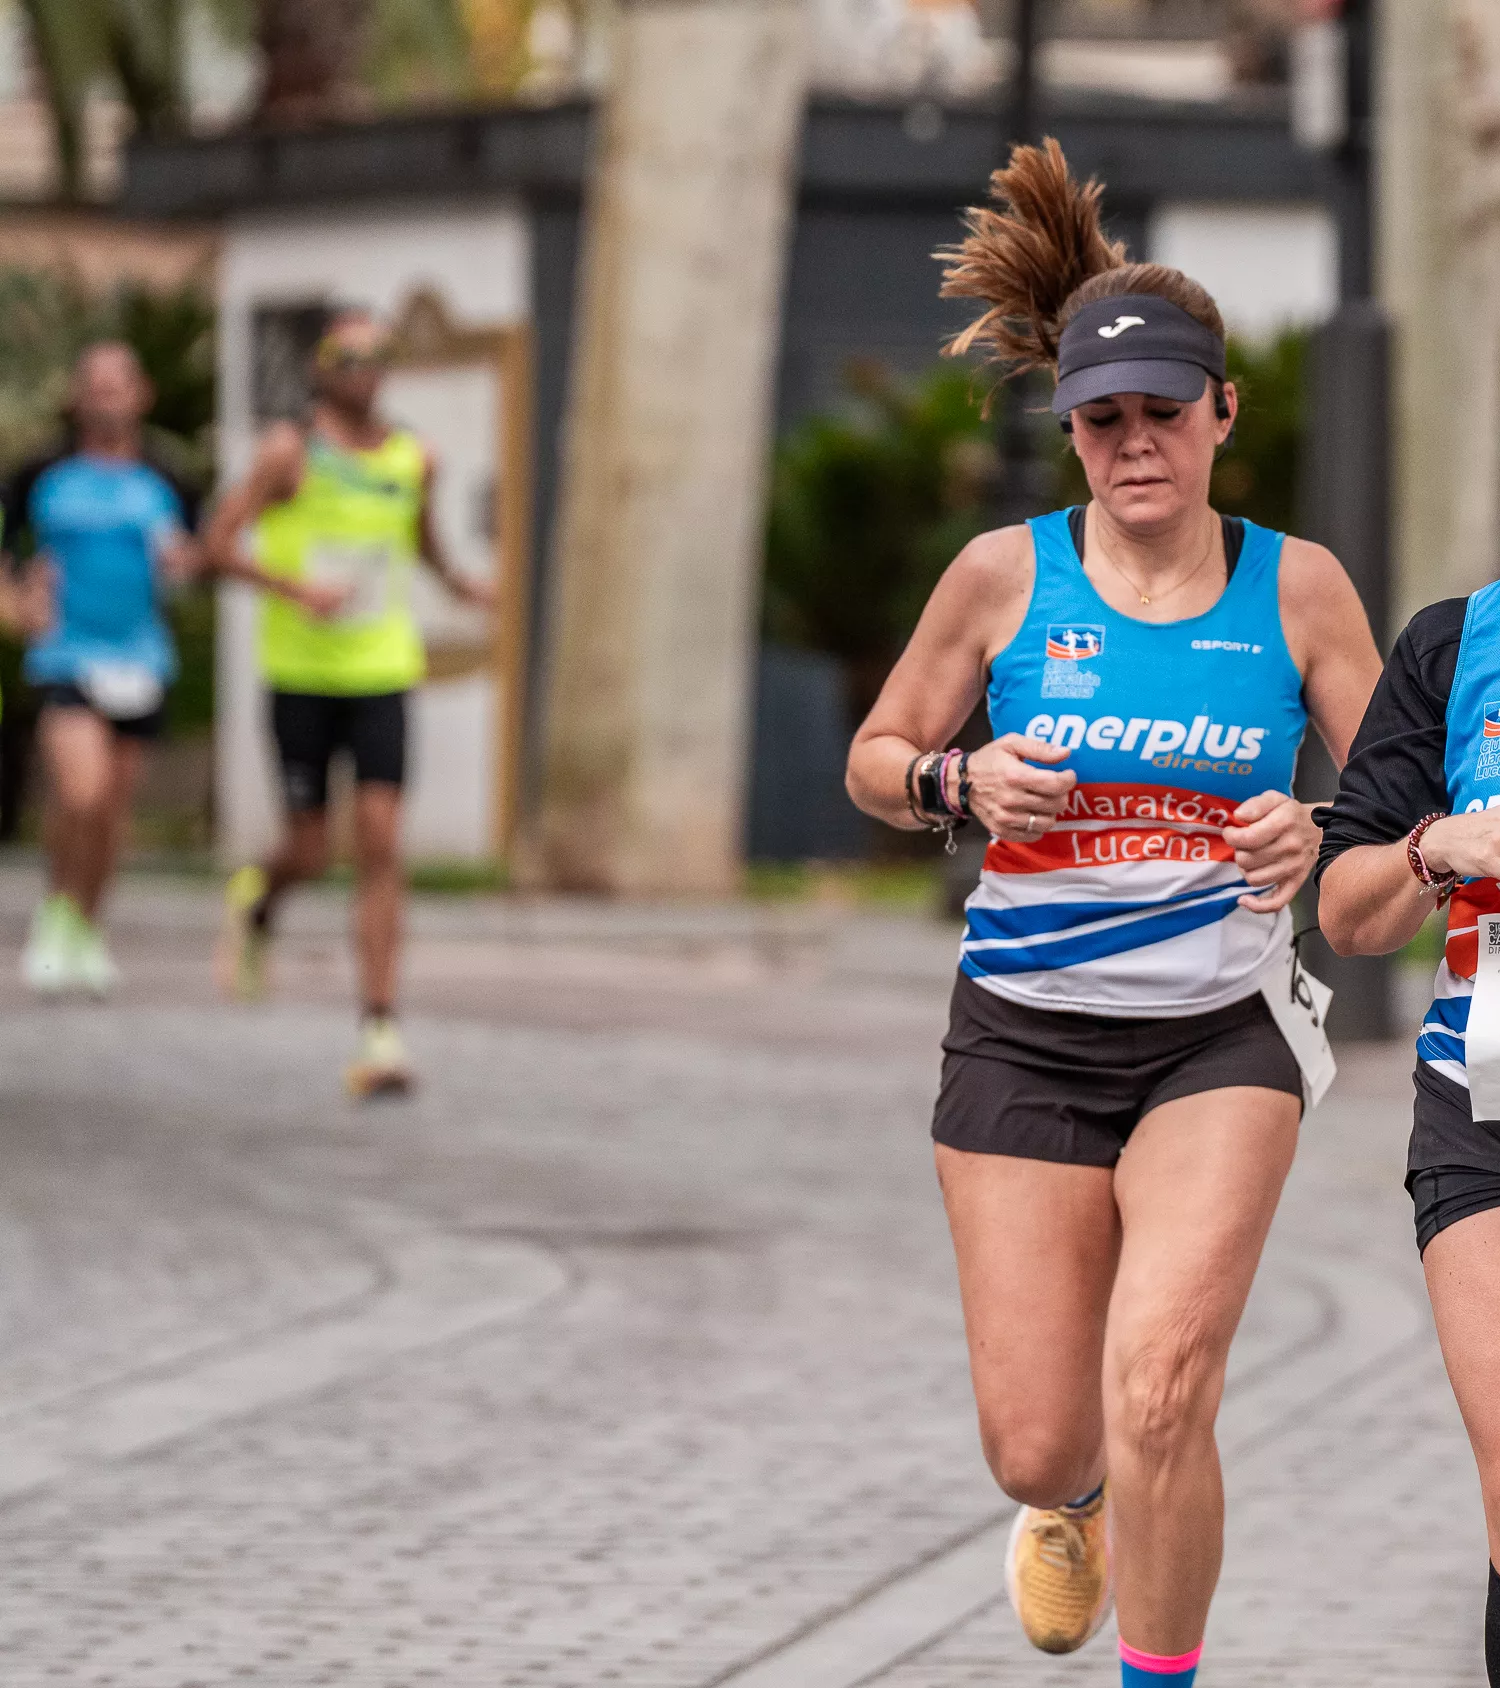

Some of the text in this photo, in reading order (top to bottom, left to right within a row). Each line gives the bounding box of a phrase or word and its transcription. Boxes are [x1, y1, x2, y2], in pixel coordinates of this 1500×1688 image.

[1191, 640, 1250, 652] GSPORT
[1025, 713, 1265, 760] enerplus
[1152, 752, 1253, 775] directo
[1060, 790, 1229, 826] Maratón
[1072, 832, 1211, 864] Lucena
